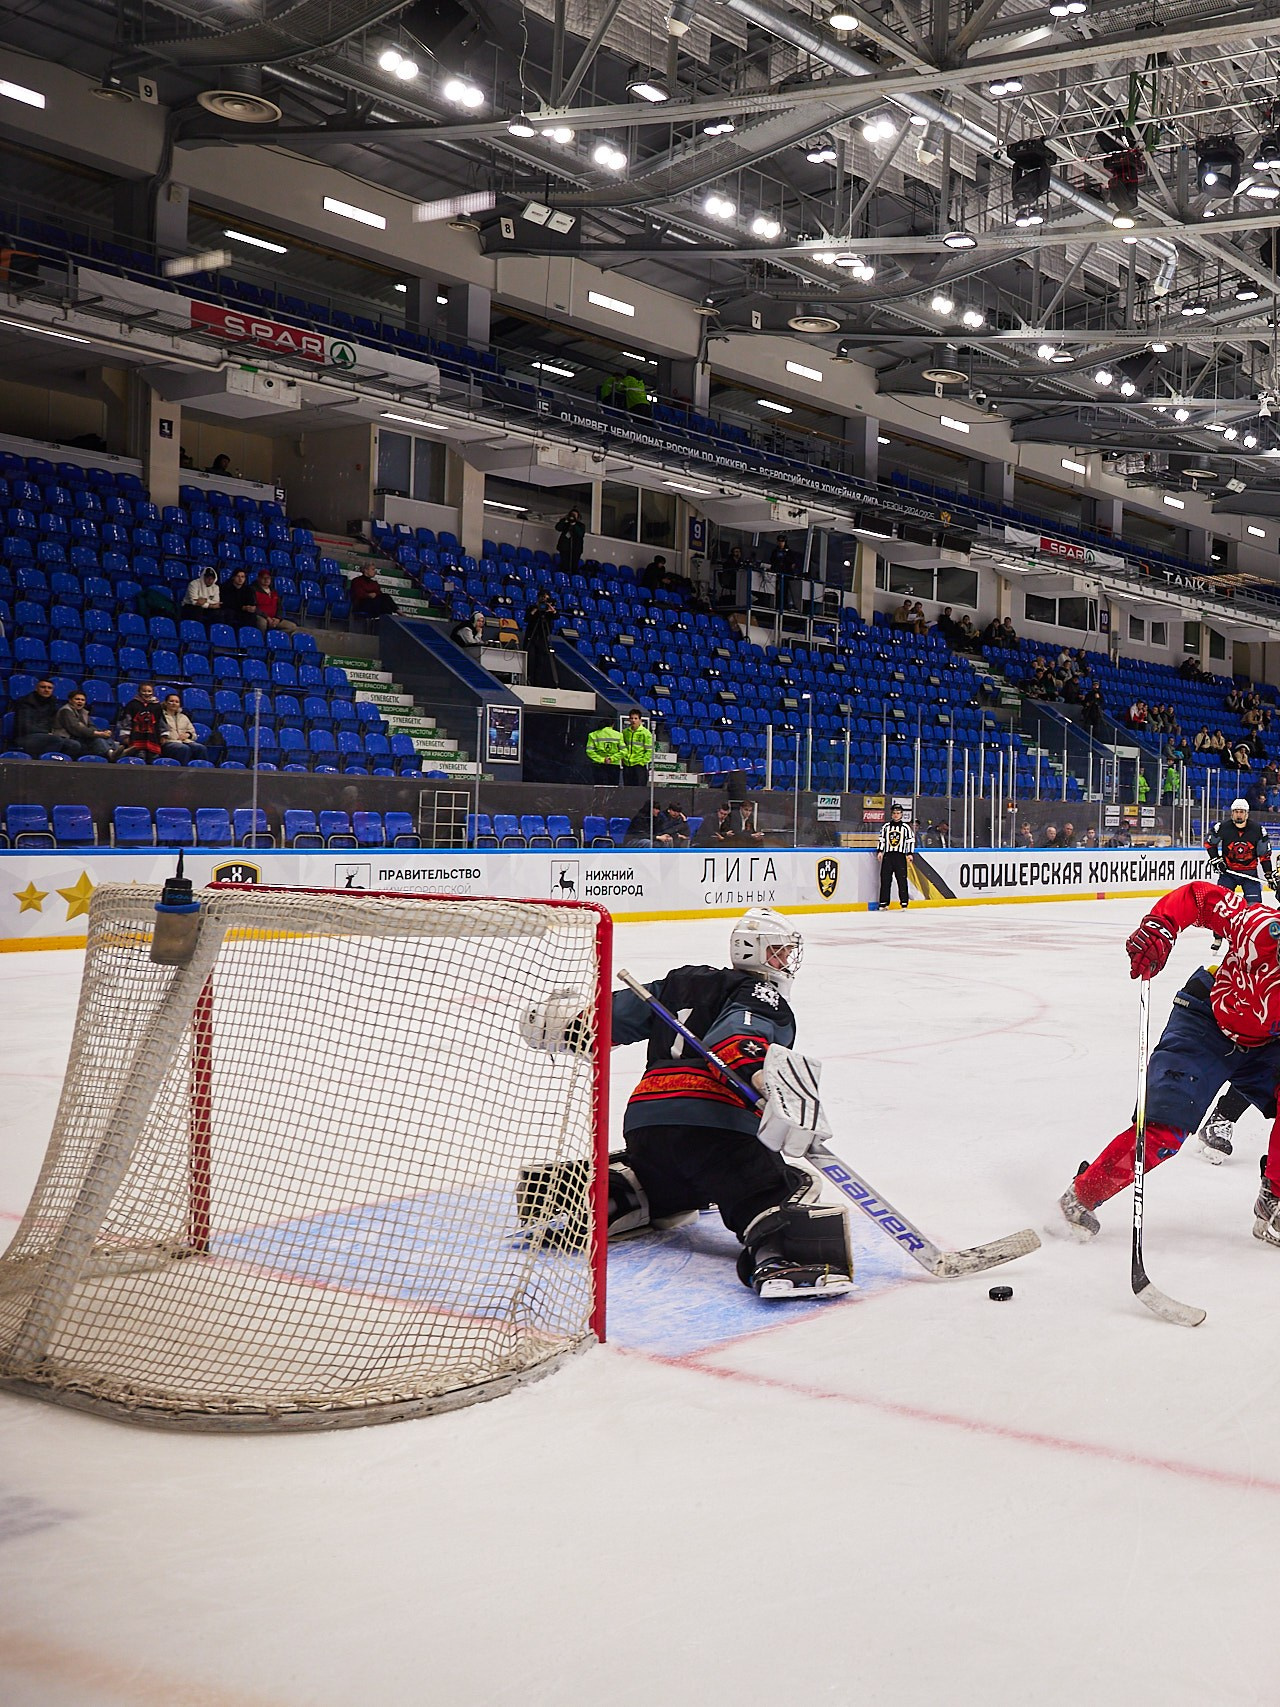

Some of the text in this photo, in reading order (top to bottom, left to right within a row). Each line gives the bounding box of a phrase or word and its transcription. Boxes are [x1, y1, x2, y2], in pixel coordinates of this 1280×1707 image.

[144, 84, 153, 97] 9
[505, 223, 511, 234] 8
[754, 315, 759, 324] 7
[224, 315, 322, 357] SPAR
[161, 422, 170, 434] 1
[560, 411, 608, 432] OLIMPBET
[610, 426, 664, 448] ЧЕМПИОНАТ
[666, 441, 699, 459] РОССИИ
[701, 451, 714, 463] ПО
[715, 455, 748, 472] ХОККЕЮ
[759, 466, 820, 489] ВСЕРОССИЙСКАЯ
[821, 483, 862, 501] ХОККЕЙНАЯ
[275, 489, 284, 500] 5
[694, 523, 702, 539] 9
[1050, 542, 1084, 559] SPAR
[1101, 612, 1109, 624] 10
[349, 671, 380, 680] SYNERGETIC
[370, 694, 400, 703] SYNERGETIC
[392, 716, 422, 725] SYNERGETIC
[416, 739, 445, 748] SYNERGETIC
[439, 762, 468, 771] SYNERGETIC
[379, 868, 481, 881] ПРАВИТЕЛЬСТВО
[585, 867, 634, 881] НИЖНИЙ
[700, 857, 778, 883] ЛИГА
[959, 854, 1212, 890] ОФИЦЕРСКАЯ ХОККЕЙНАЯ ЛИГА
[585, 884, 644, 897] НОВГОРОД
[704, 889, 775, 905] СИЛЬНЫХ
[743, 1010, 752, 1025] 1
[821, 1164, 925, 1253] BAUER
